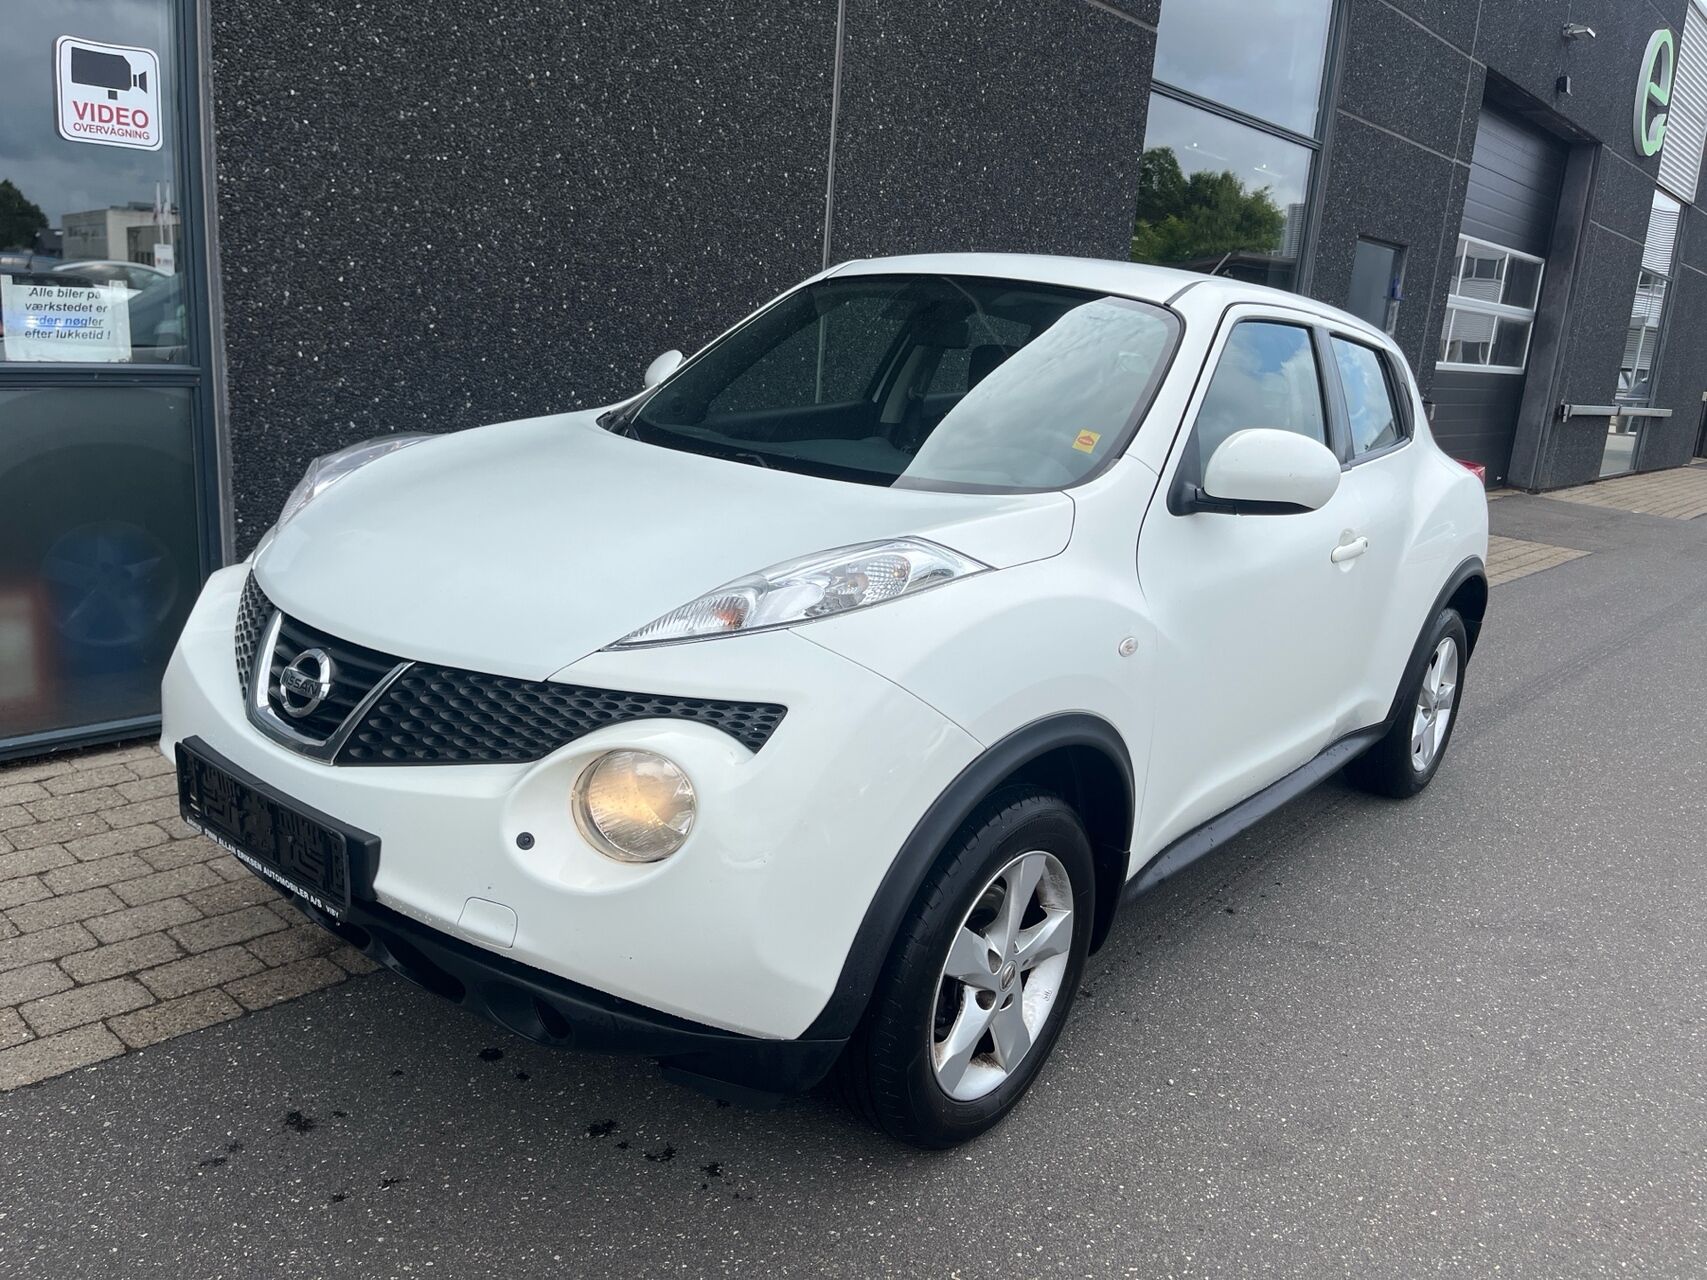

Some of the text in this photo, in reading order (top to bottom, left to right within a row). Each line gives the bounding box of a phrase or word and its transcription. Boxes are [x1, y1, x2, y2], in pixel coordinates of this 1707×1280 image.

[72, 100, 149, 129] VIDEO
[73, 122, 150, 140] OVERVÅGNING
[28, 287, 53, 298] Alle
[57, 288, 84, 299] biler
[25, 303, 108, 313] værkstedet er
[65, 317, 104, 328] nøgler
[24, 330, 53, 339] efter
[56, 329, 104, 340] lukketid
[283, 670, 318, 696] NISSAN
[237, 849, 263, 872] ERIKSEN
[263, 866, 310, 902] AUTOMOBILER
[310, 894, 323, 909] A/S
